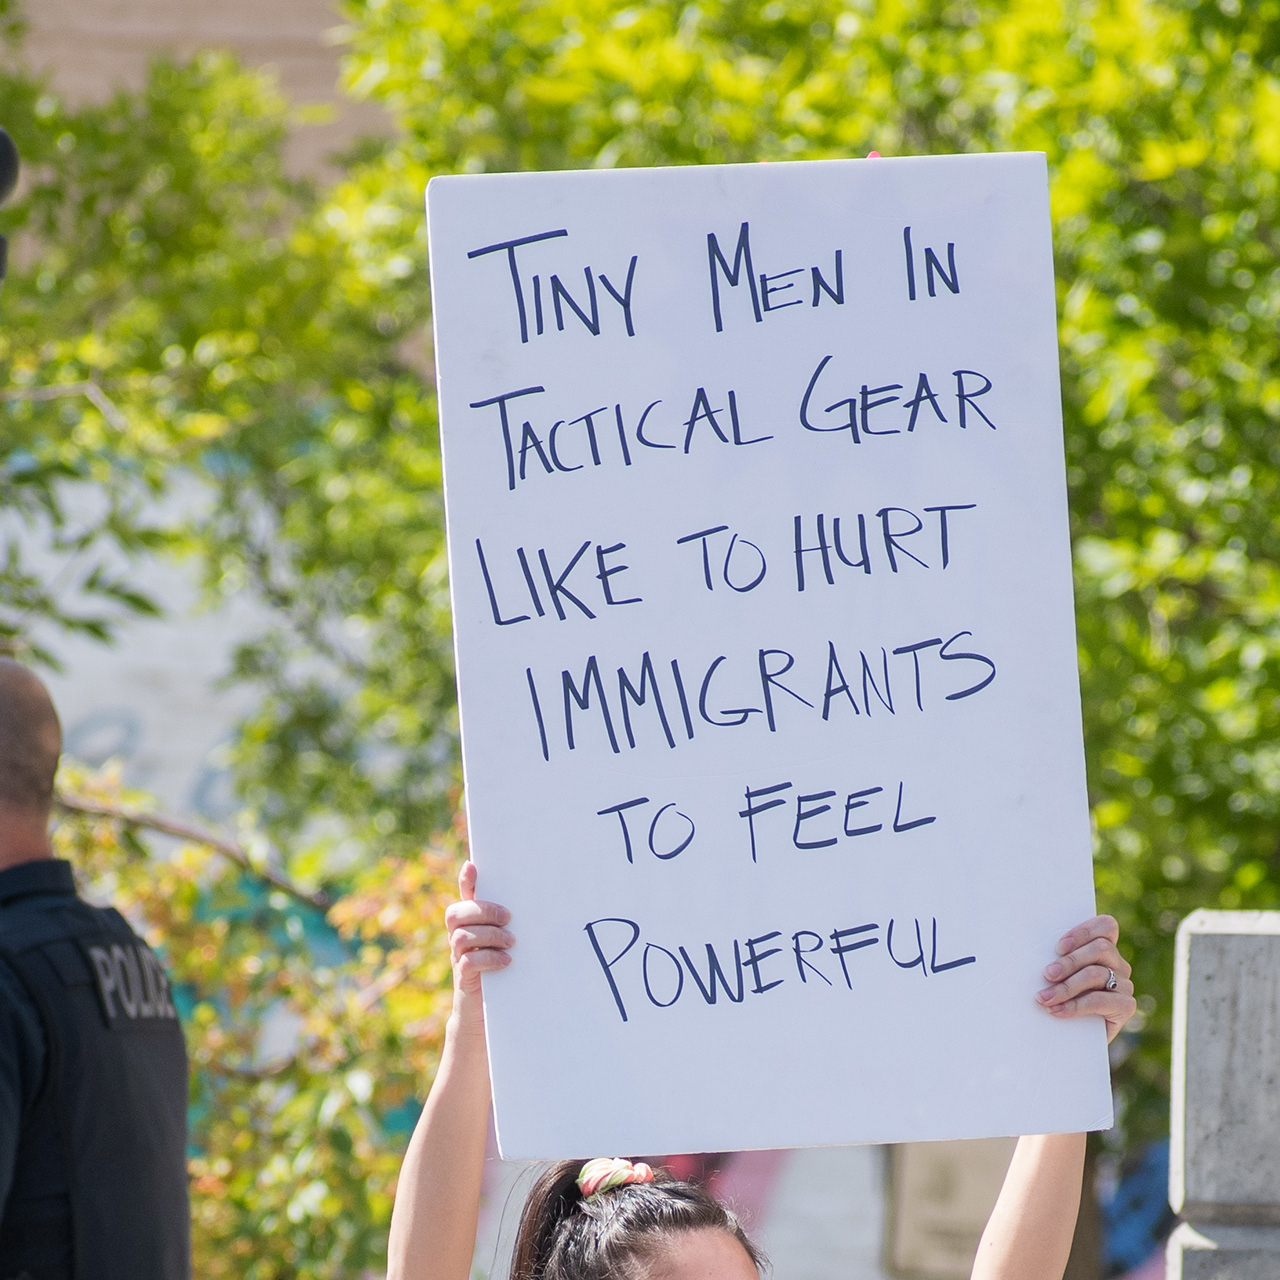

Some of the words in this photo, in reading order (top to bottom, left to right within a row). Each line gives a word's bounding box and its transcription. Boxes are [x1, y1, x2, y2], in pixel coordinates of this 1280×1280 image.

[466, 228, 638, 344] TINY
[706, 221, 845, 333] MEN
[903, 226, 961, 301] IN
[469, 385, 774, 491] TACTICAL
[799, 355, 997, 445] GEAR
[475, 538, 643, 626] LIKE
[676, 525, 767, 593] TO
[793, 503, 977, 592] HURT
[526, 631, 996, 762] IMMIGRANTS
[596, 796, 695, 865] TO
[738, 781, 937, 864] FEEL
[583, 916, 977, 1023] POWERFUL
